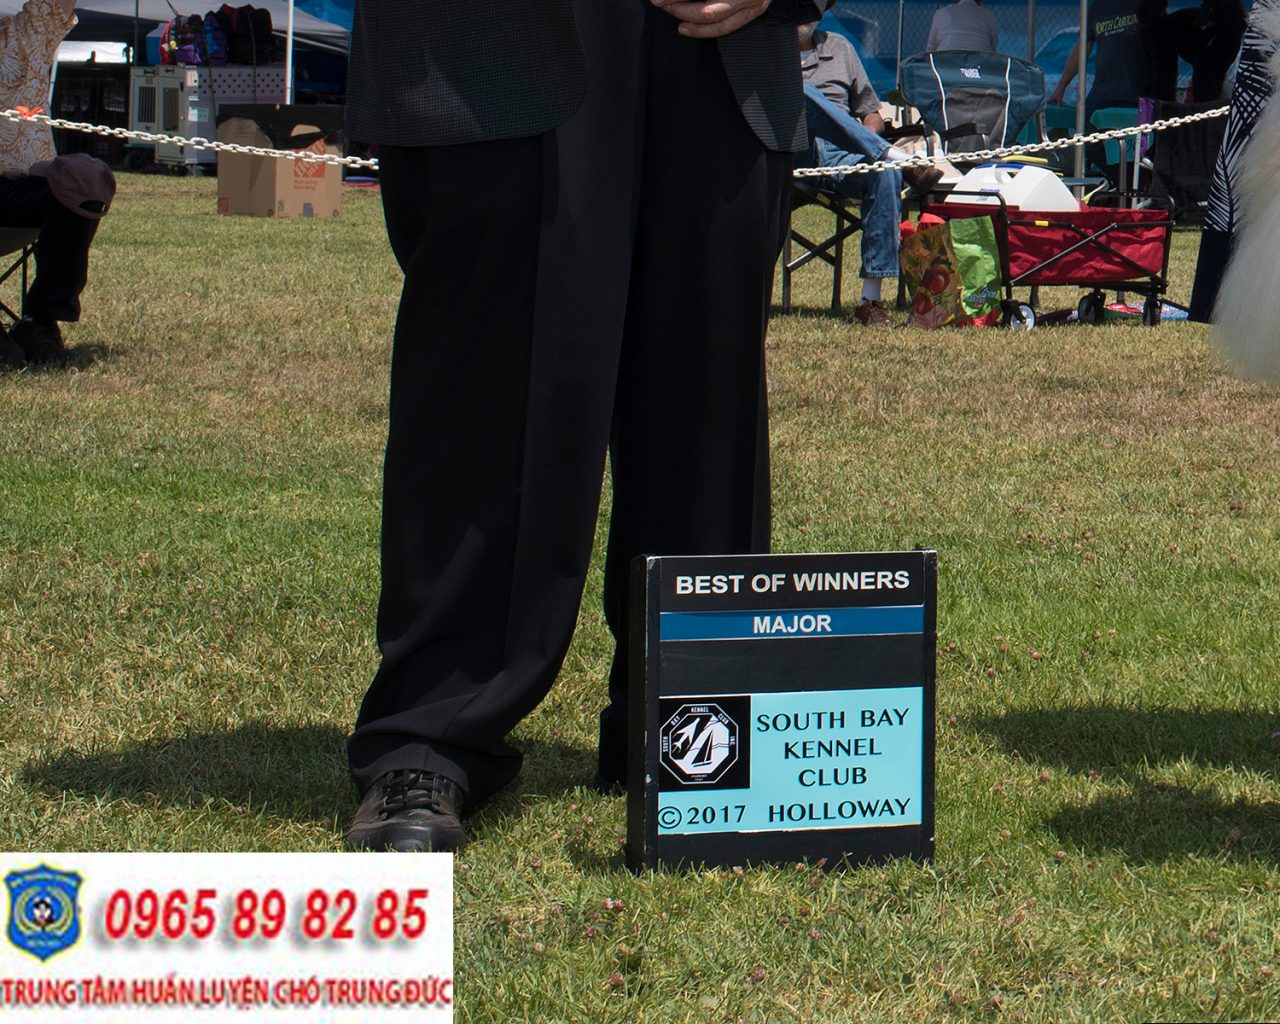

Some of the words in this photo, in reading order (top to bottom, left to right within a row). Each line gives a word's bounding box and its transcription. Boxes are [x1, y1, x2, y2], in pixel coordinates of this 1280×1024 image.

[676, 575, 745, 594] BEST
[751, 574, 786, 593] OF
[793, 571, 910, 592] WINNERS
[753, 614, 832, 634] MAJOR
[757, 712, 845, 732] SOUTH
[860, 708, 910, 728] BAY
[784, 738, 883, 759] KENNEL
[798, 767, 867, 787] CLUB
[768, 798, 911, 822] HOLLOWAY
